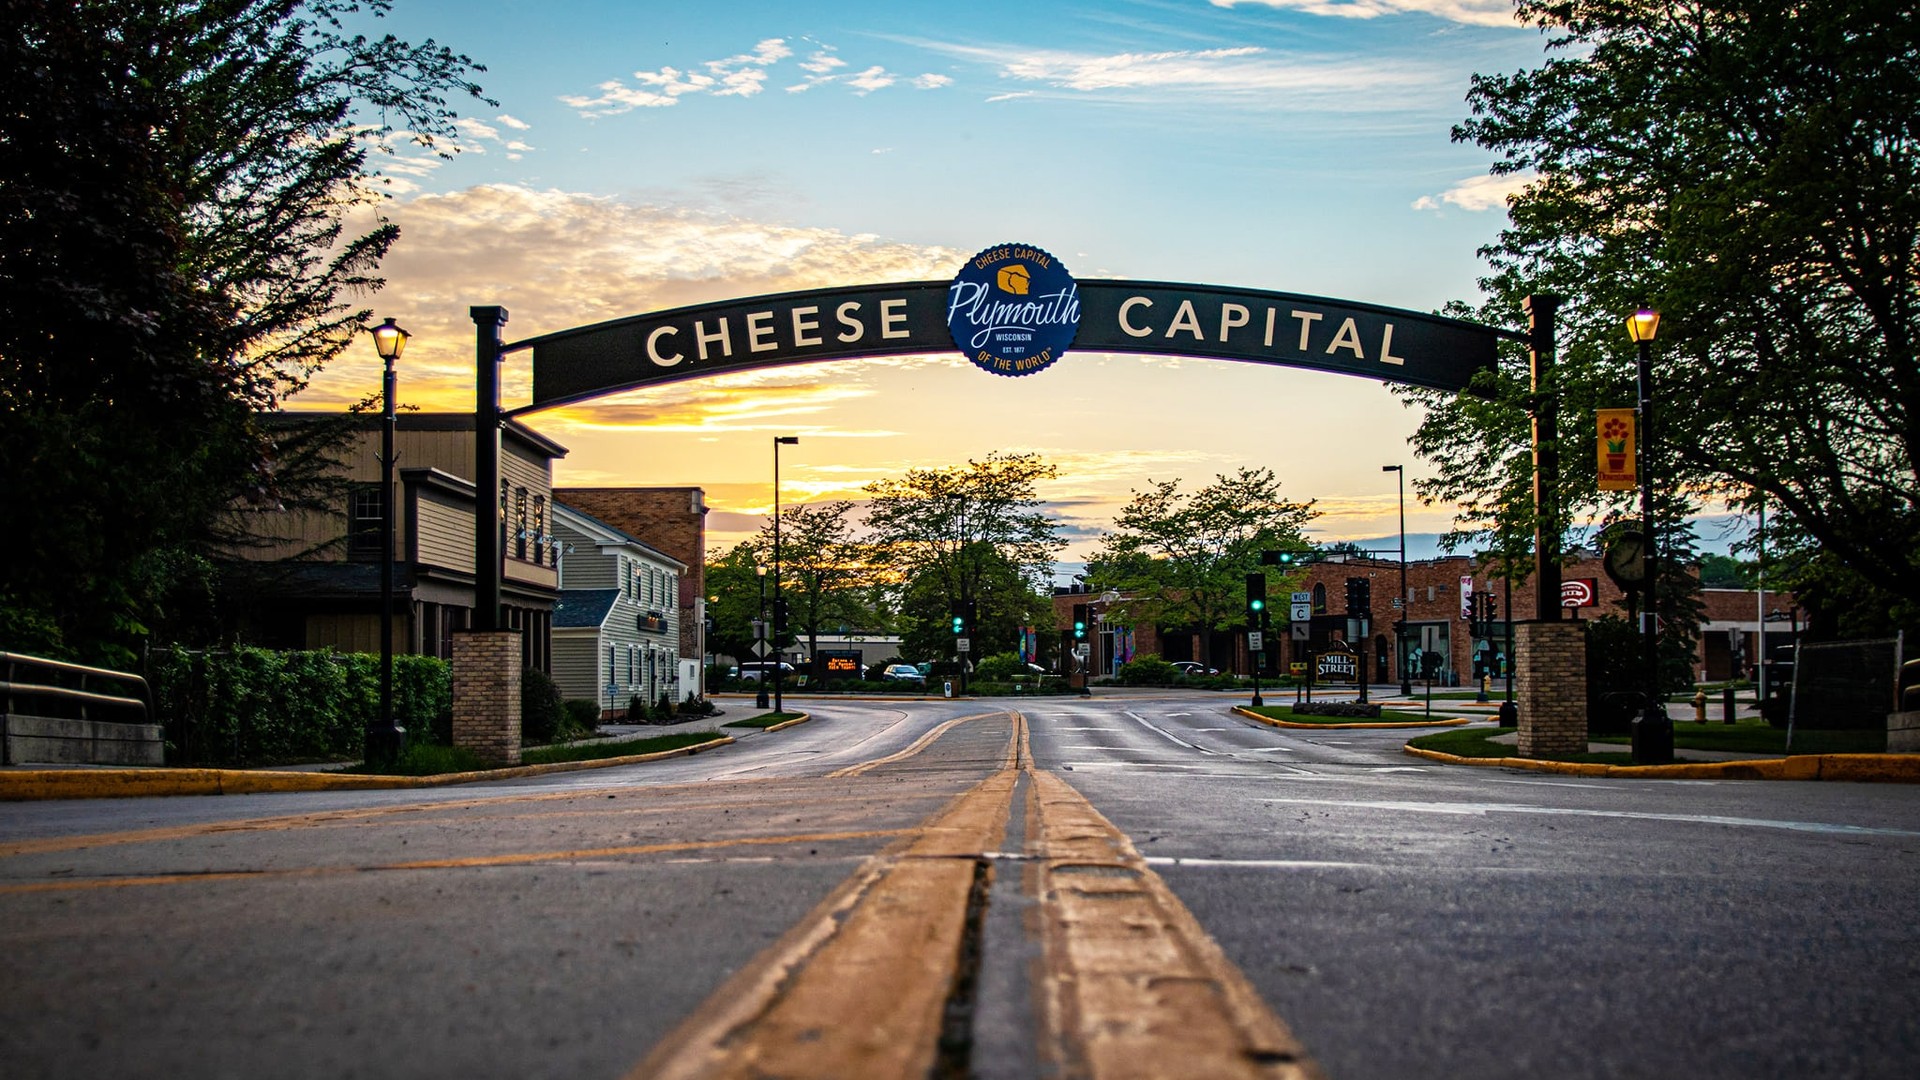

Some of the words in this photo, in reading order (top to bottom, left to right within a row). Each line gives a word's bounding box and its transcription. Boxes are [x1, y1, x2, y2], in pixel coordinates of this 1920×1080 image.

[975, 248, 1011, 270] CHEESE
[1014, 248, 1051, 270] CAPITAL
[947, 280, 1081, 349] Plymouth
[646, 298, 911, 367] CHEESE
[1118, 296, 1405, 366] CAPITAL
[995, 333, 1032, 342] WISCONSIN
[977, 350, 992, 362] OF
[993, 357, 1012, 371] THE
[1293, 593, 1308, 601] WEST
[1296, 609, 1305, 619] C
[1325, 655, 1349, 664] MILL
[1318, 663, 1357, 676] STREET
